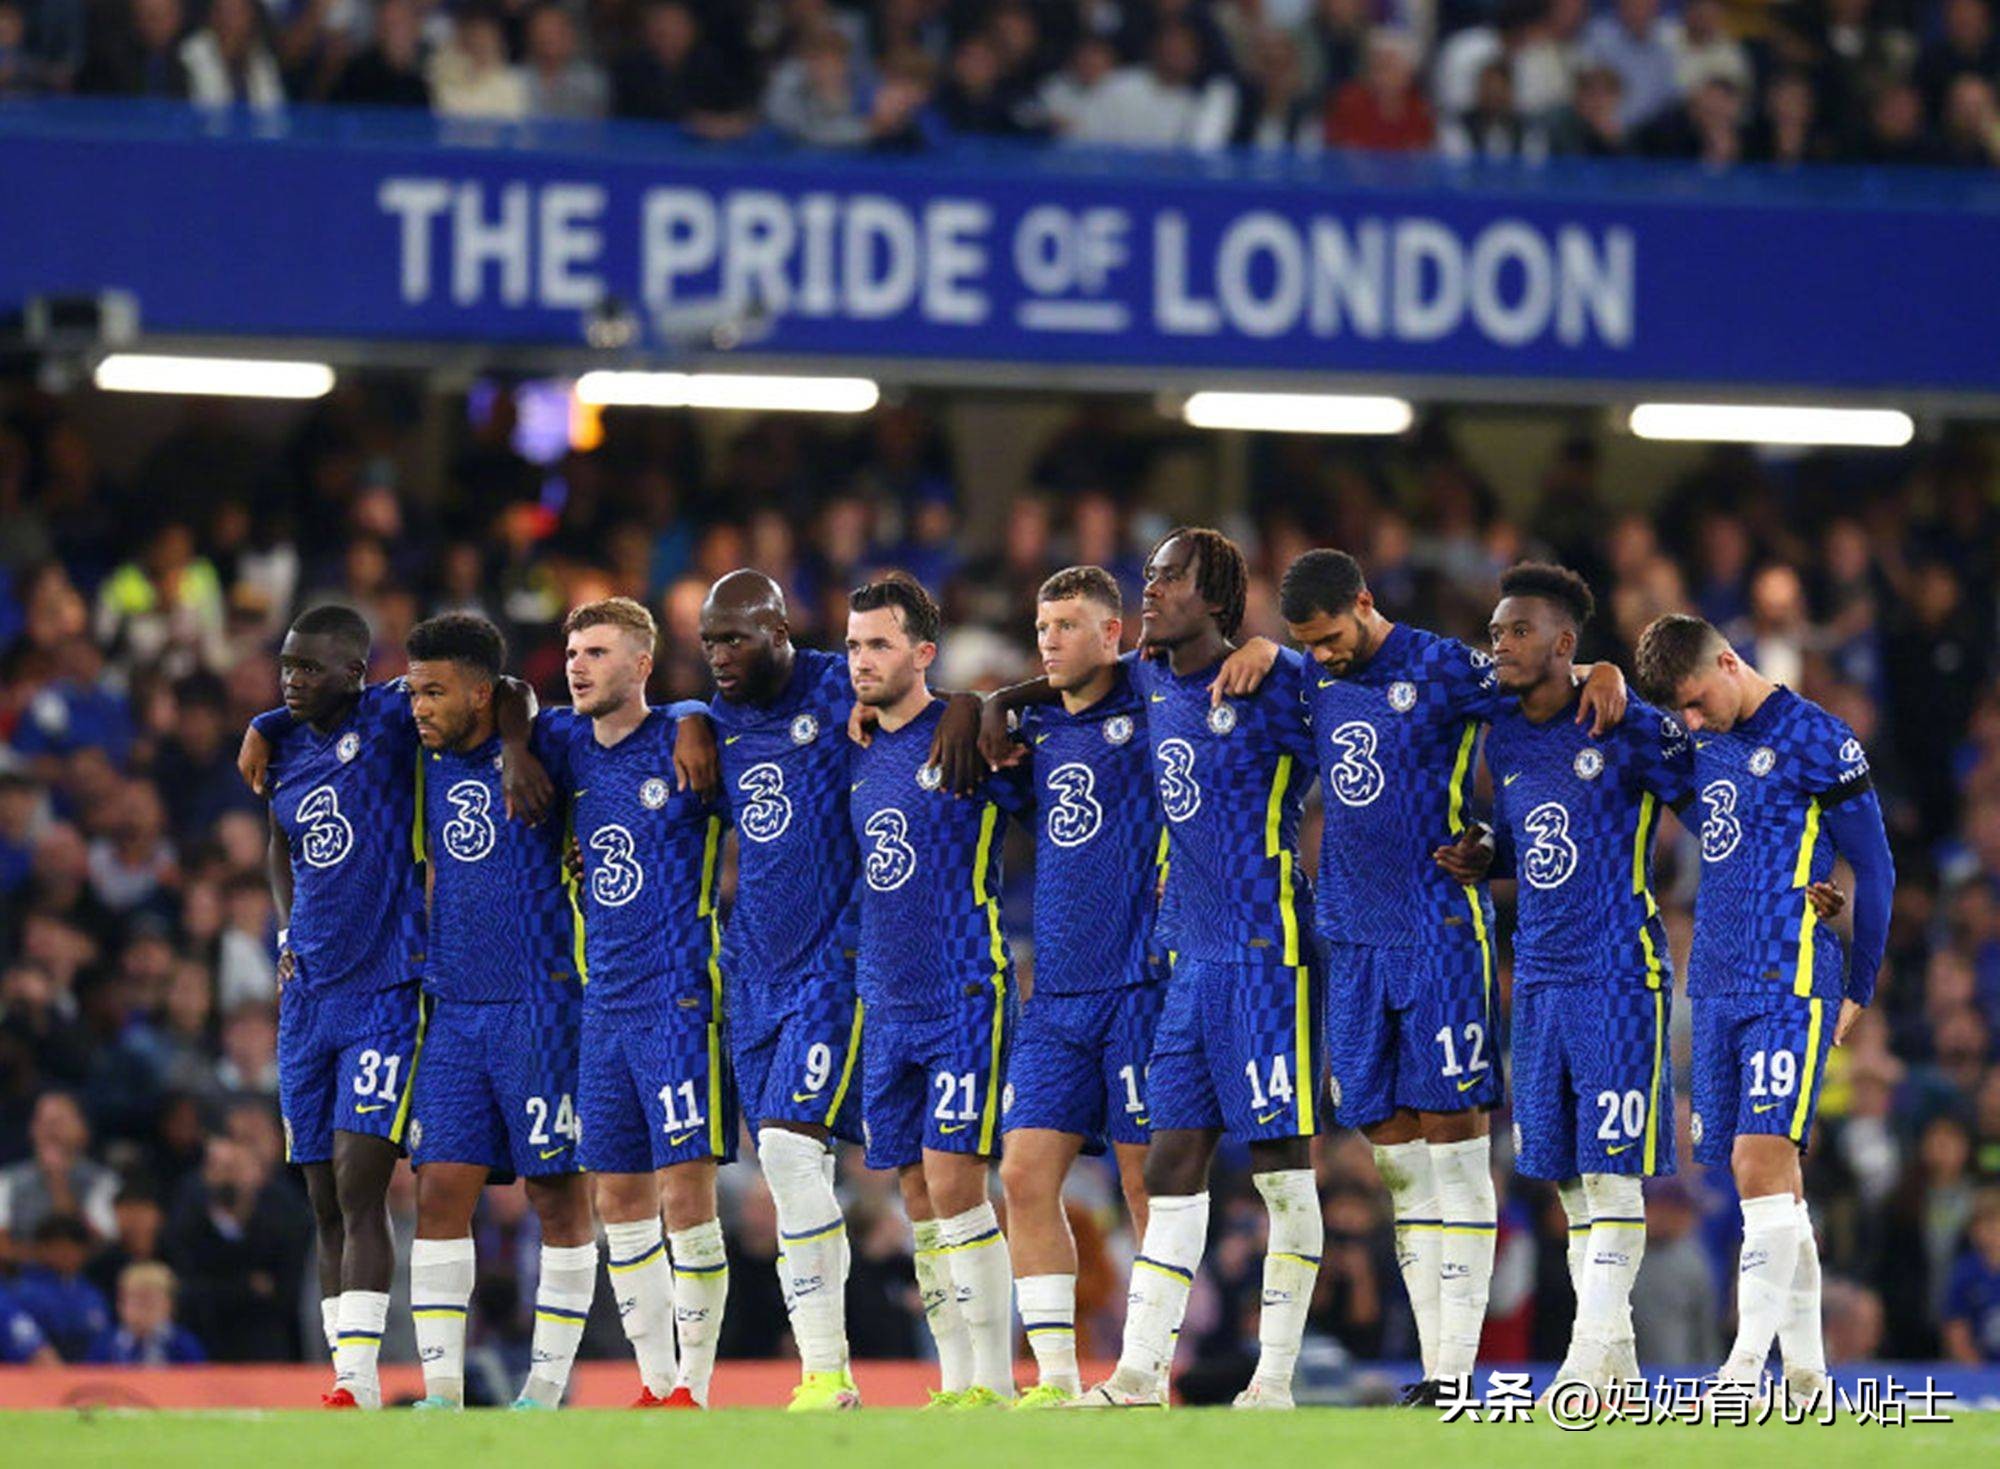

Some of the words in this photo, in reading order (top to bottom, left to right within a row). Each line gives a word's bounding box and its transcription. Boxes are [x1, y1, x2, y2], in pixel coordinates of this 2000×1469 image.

[377, 178, 607, 308] THE
[641, 186, 992, 324] PRIDE
[1014, 204, 1129, 295] OF
[1152, 209, 1635, 348] LONDON
[739, 762, 792, 841] 3
[1157, 738, 1201, 822] 3
[1331, 720, 1386, 806] 3
[296, 786, 352, 867] 3
[444, 780, 495, 861] 3
[1047, 762, 1102, 847] 3
[1701, 780, 1741, 862] 3
[590, 824, 643, 906] 3
[865, 808, 916, 891] 3
[1525, 802, 1577, 889] 3
[354, 1049, 400, 1102] 31
[804, 1042, 831, 1091] 9
[1119, 1064, 1153, 1112] 1
[1245, 1054, 1293, 1109] 14
[1436, 1022, 1488, 1076] 12
[1749, 1050, 1796, 1097] 19
[525, 1093, 576, 1145] 24
[658, 1079, 705, 1133] 11
[934, 1071, 978, 1120] 21
[1597, 1090, 1645, 1140] 20
